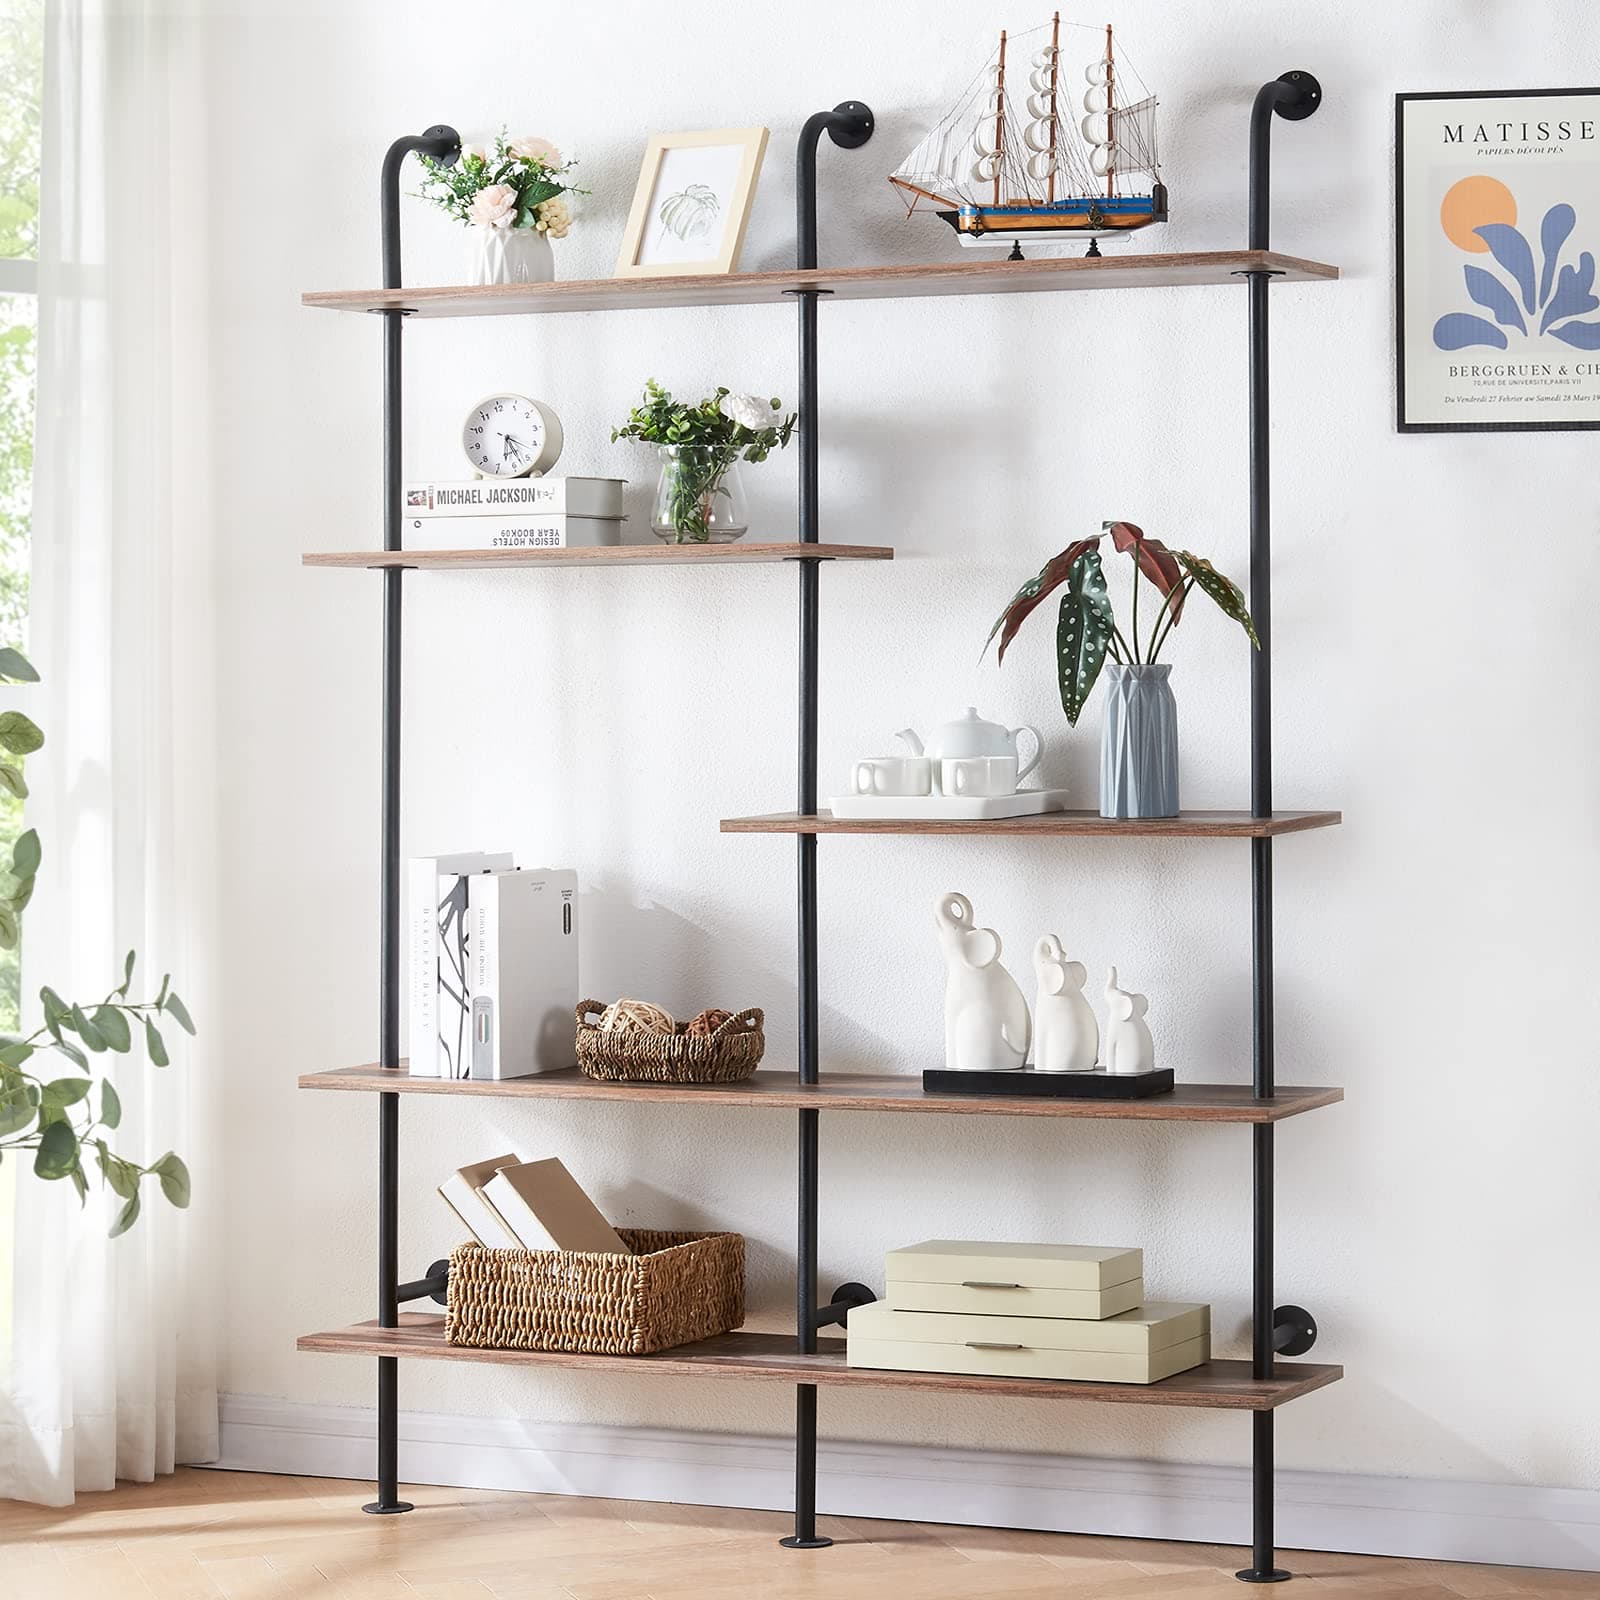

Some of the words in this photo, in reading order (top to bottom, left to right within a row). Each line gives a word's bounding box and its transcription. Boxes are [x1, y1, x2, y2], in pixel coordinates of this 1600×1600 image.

[1443, 121, 1595, 143] MATISSE
[1449, 365, 1551, 377] BERGGRUEN
[1558, 365, 1568, 375] &
[1536, 394, 1561, 402] Samedi
[481, 413, 490, 421] 11
[474, 426, 483, 434] 10
[437, 489, 483, 505] MICHAEL
[486, 487, 536, 504] JACKSON
[537, 528, 560, 537] YEAR
[493, 537, 526, 546] HOTELS
[529, 537, 560, 546] DESIGN
